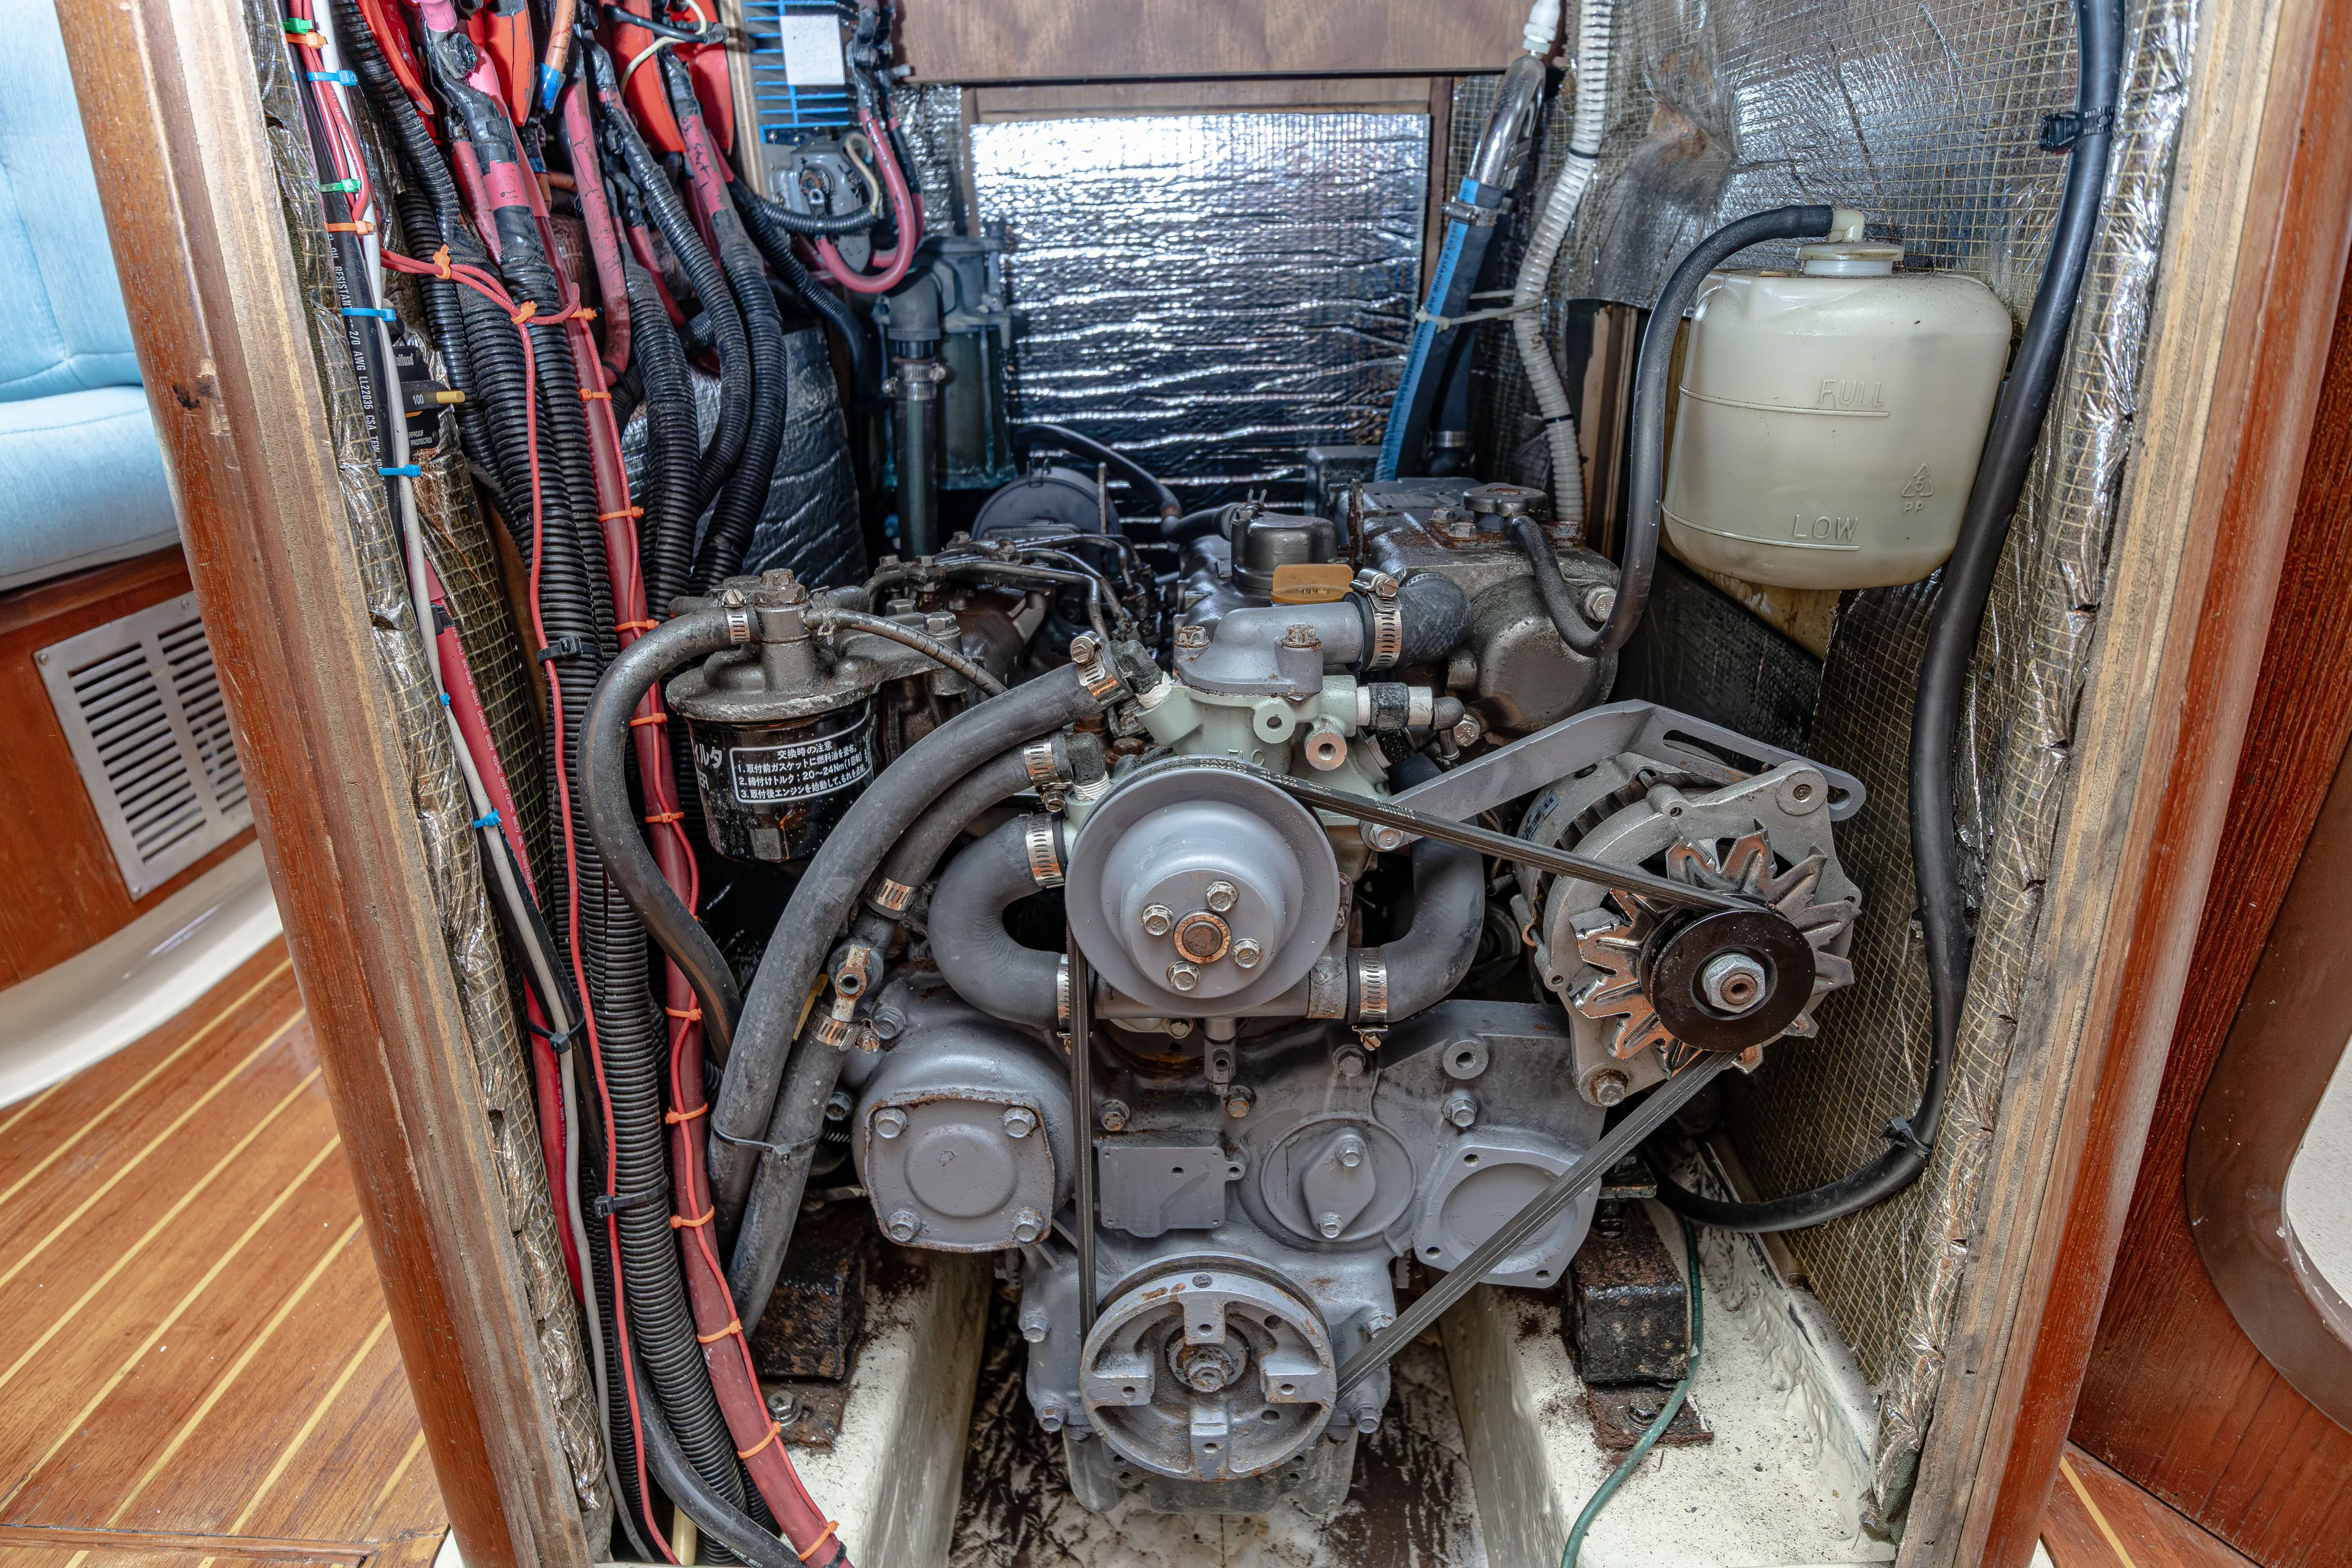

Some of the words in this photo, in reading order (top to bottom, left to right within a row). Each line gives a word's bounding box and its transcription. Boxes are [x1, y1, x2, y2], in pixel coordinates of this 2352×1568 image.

[334, 266, 352, 308] RESISTAN
[349, 330, 361, 345] 2/0
[353, 350, 366, 371] AWG
[412, 394, 424, 405] 100
[1817, 379, 1885, 407] FULL
[365, 415, 376, 431] CSA
[410, 437, 432, 447] PROTECTED
[1902, 500, 1926, 515] PP
[1792, 513, 1859, 541] LOW
[777, 741, 832, 760] 交換時の注意
[470, 688, 480, 707] BOAT
[477, 710, 488, 732] CABLE
[485, 734, 494, 751] 600V
[499, 775, 508, 791] DRY
[521, 849, 533, 886] RESISTANT
